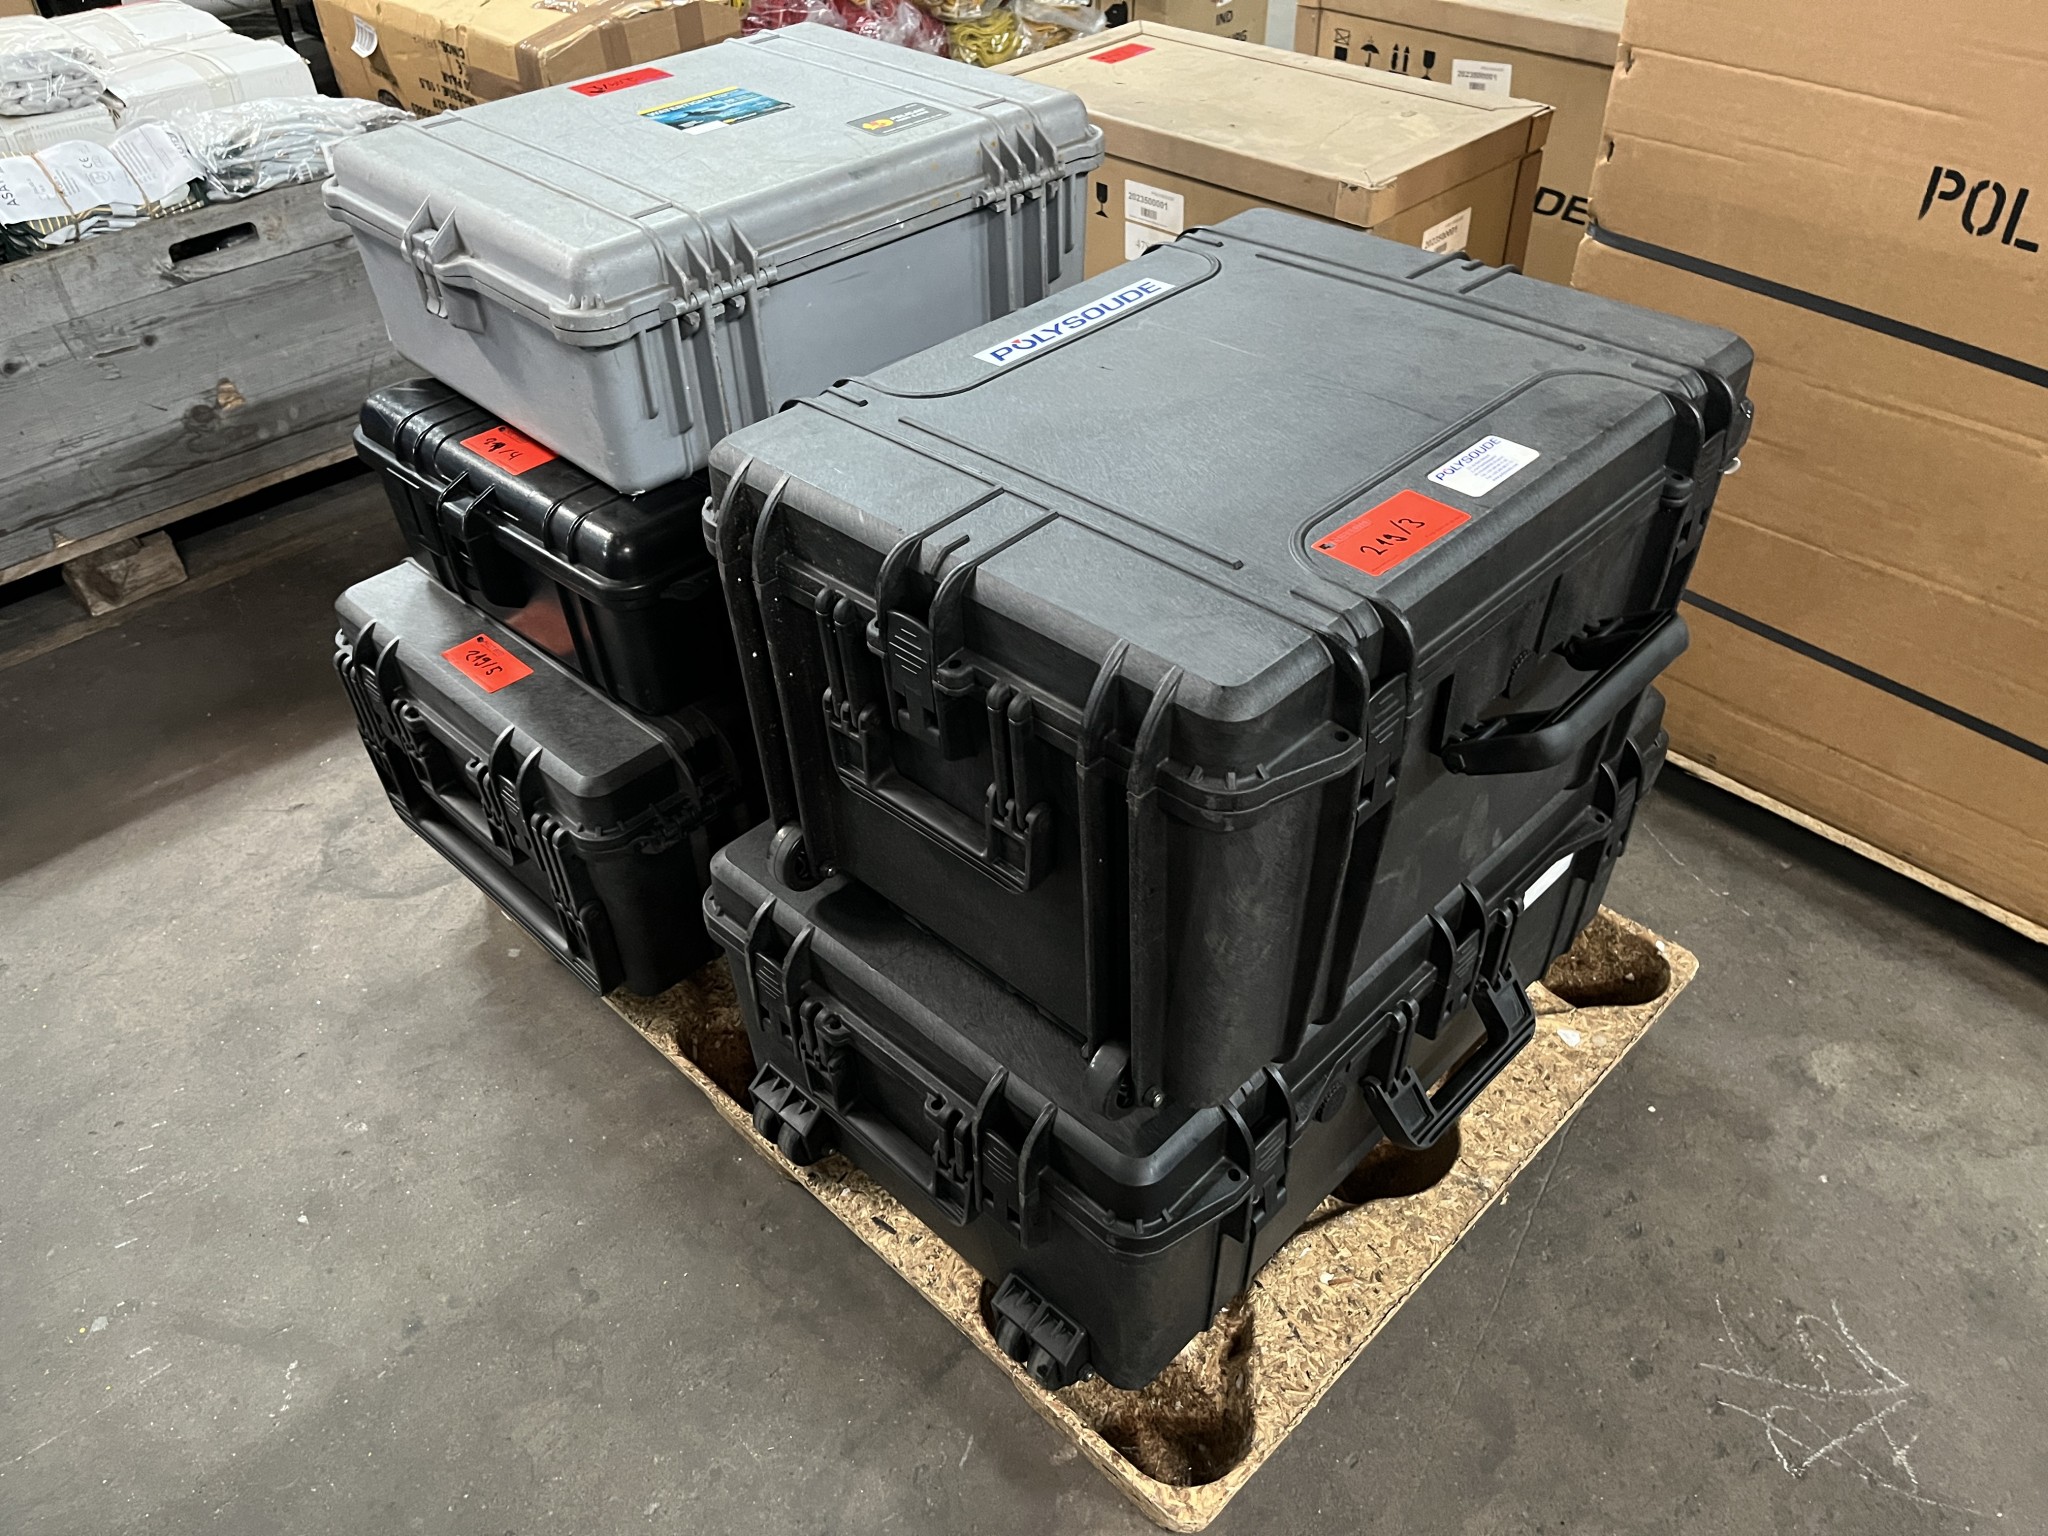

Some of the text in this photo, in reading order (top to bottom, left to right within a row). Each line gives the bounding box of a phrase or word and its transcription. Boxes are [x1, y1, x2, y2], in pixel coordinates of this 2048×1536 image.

[1917, 165, 2040, 253] POL
[989, 281, 1162, 362] POLYSOUDE
[1434, 437, 1502, 482] POLYSOUDE
[1359, 517, 1426, 557] 219/3
[465, 649, 503, 676] 219/5
